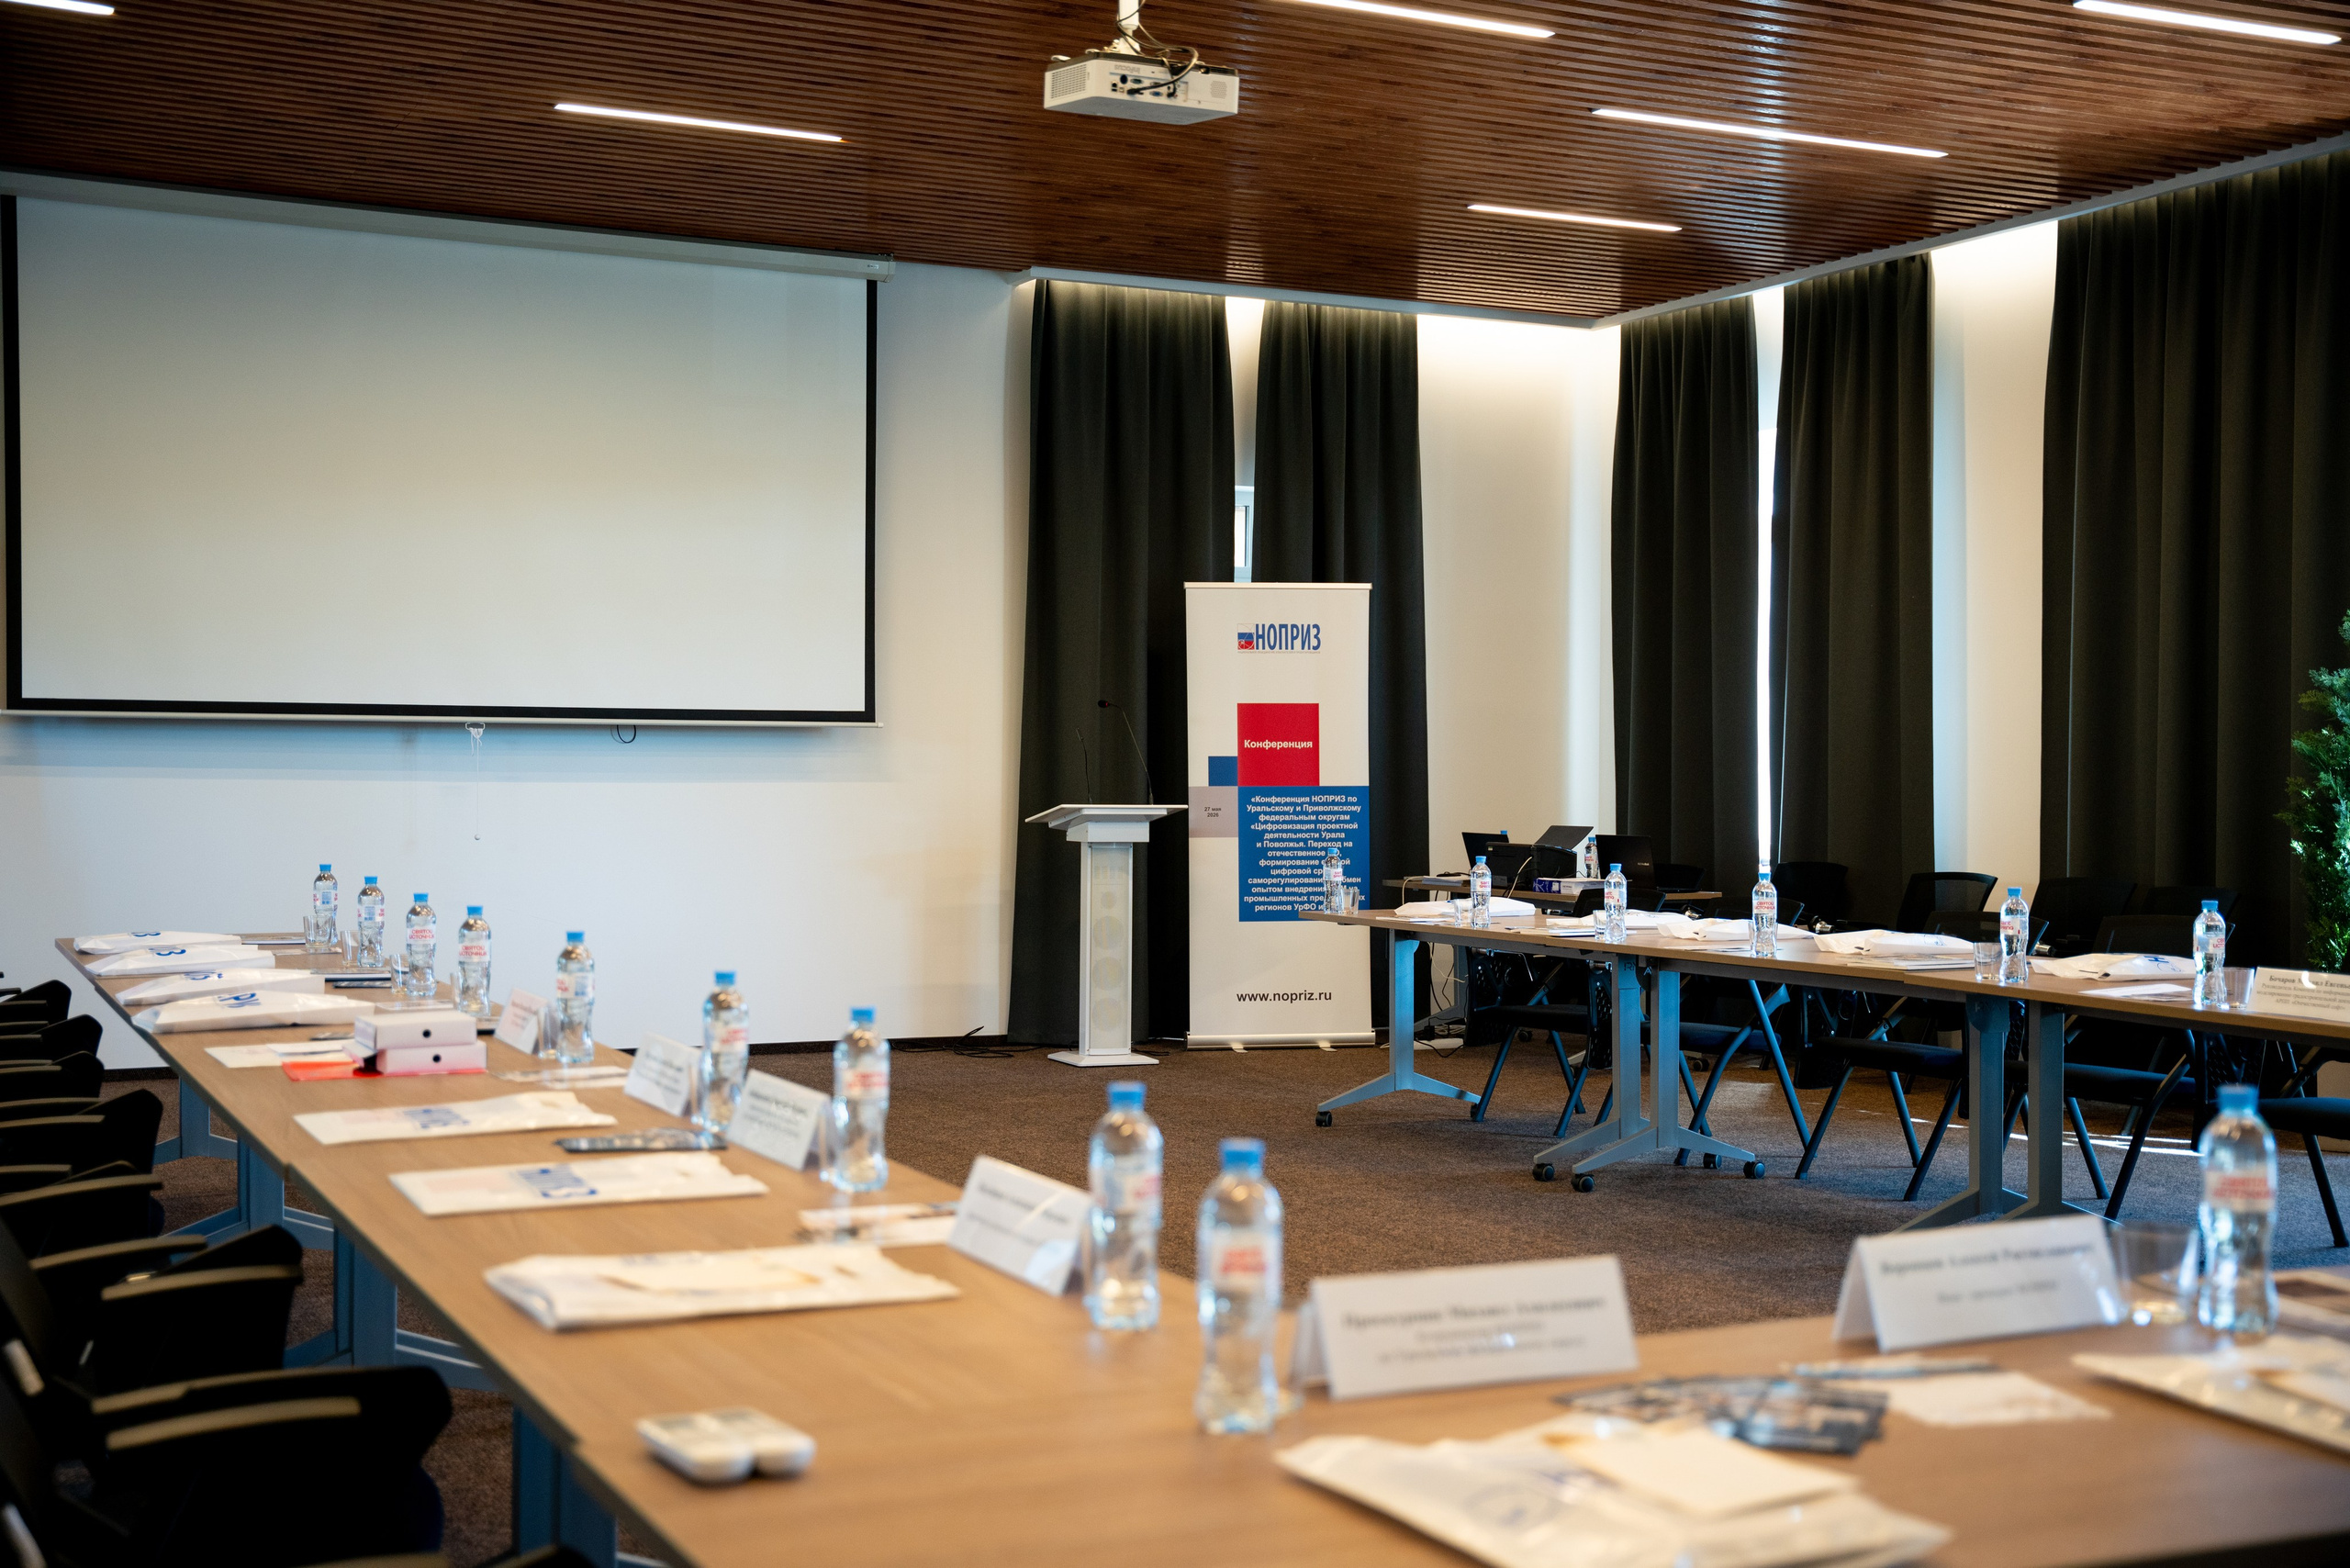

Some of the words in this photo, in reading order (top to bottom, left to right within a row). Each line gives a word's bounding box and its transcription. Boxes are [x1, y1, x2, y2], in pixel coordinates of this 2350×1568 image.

[1255, 623, 1321, 650] НОПРИЗ
[1244, 739, 1313, 750] Конференция
[1251, 795, 1310, 804] «Конференция
[1247, 804, 1294, 813] Уральскому
[1304, 804, 1361, 813] Приволжскому
[1259, 813, 1316, 822] федеральным
[1250, 823, 1315, 831] «Цифровизация
[1316, 822, 1359, 831] проектной
[1321, 831, 1346, 839] Урала
[1307, 840, 1342, 848] Переход
[1259, 858, 1319, 868] формирование
[1270, 868, 1312, 876] цифровой
[1244, 895, 1308, 903] промышленных
[1255, 904, 1292, 913] регионов
[1293, 903, 1316, 912] УрФО
[1237, 990, 1332, 1003] www.nopriz.ru
